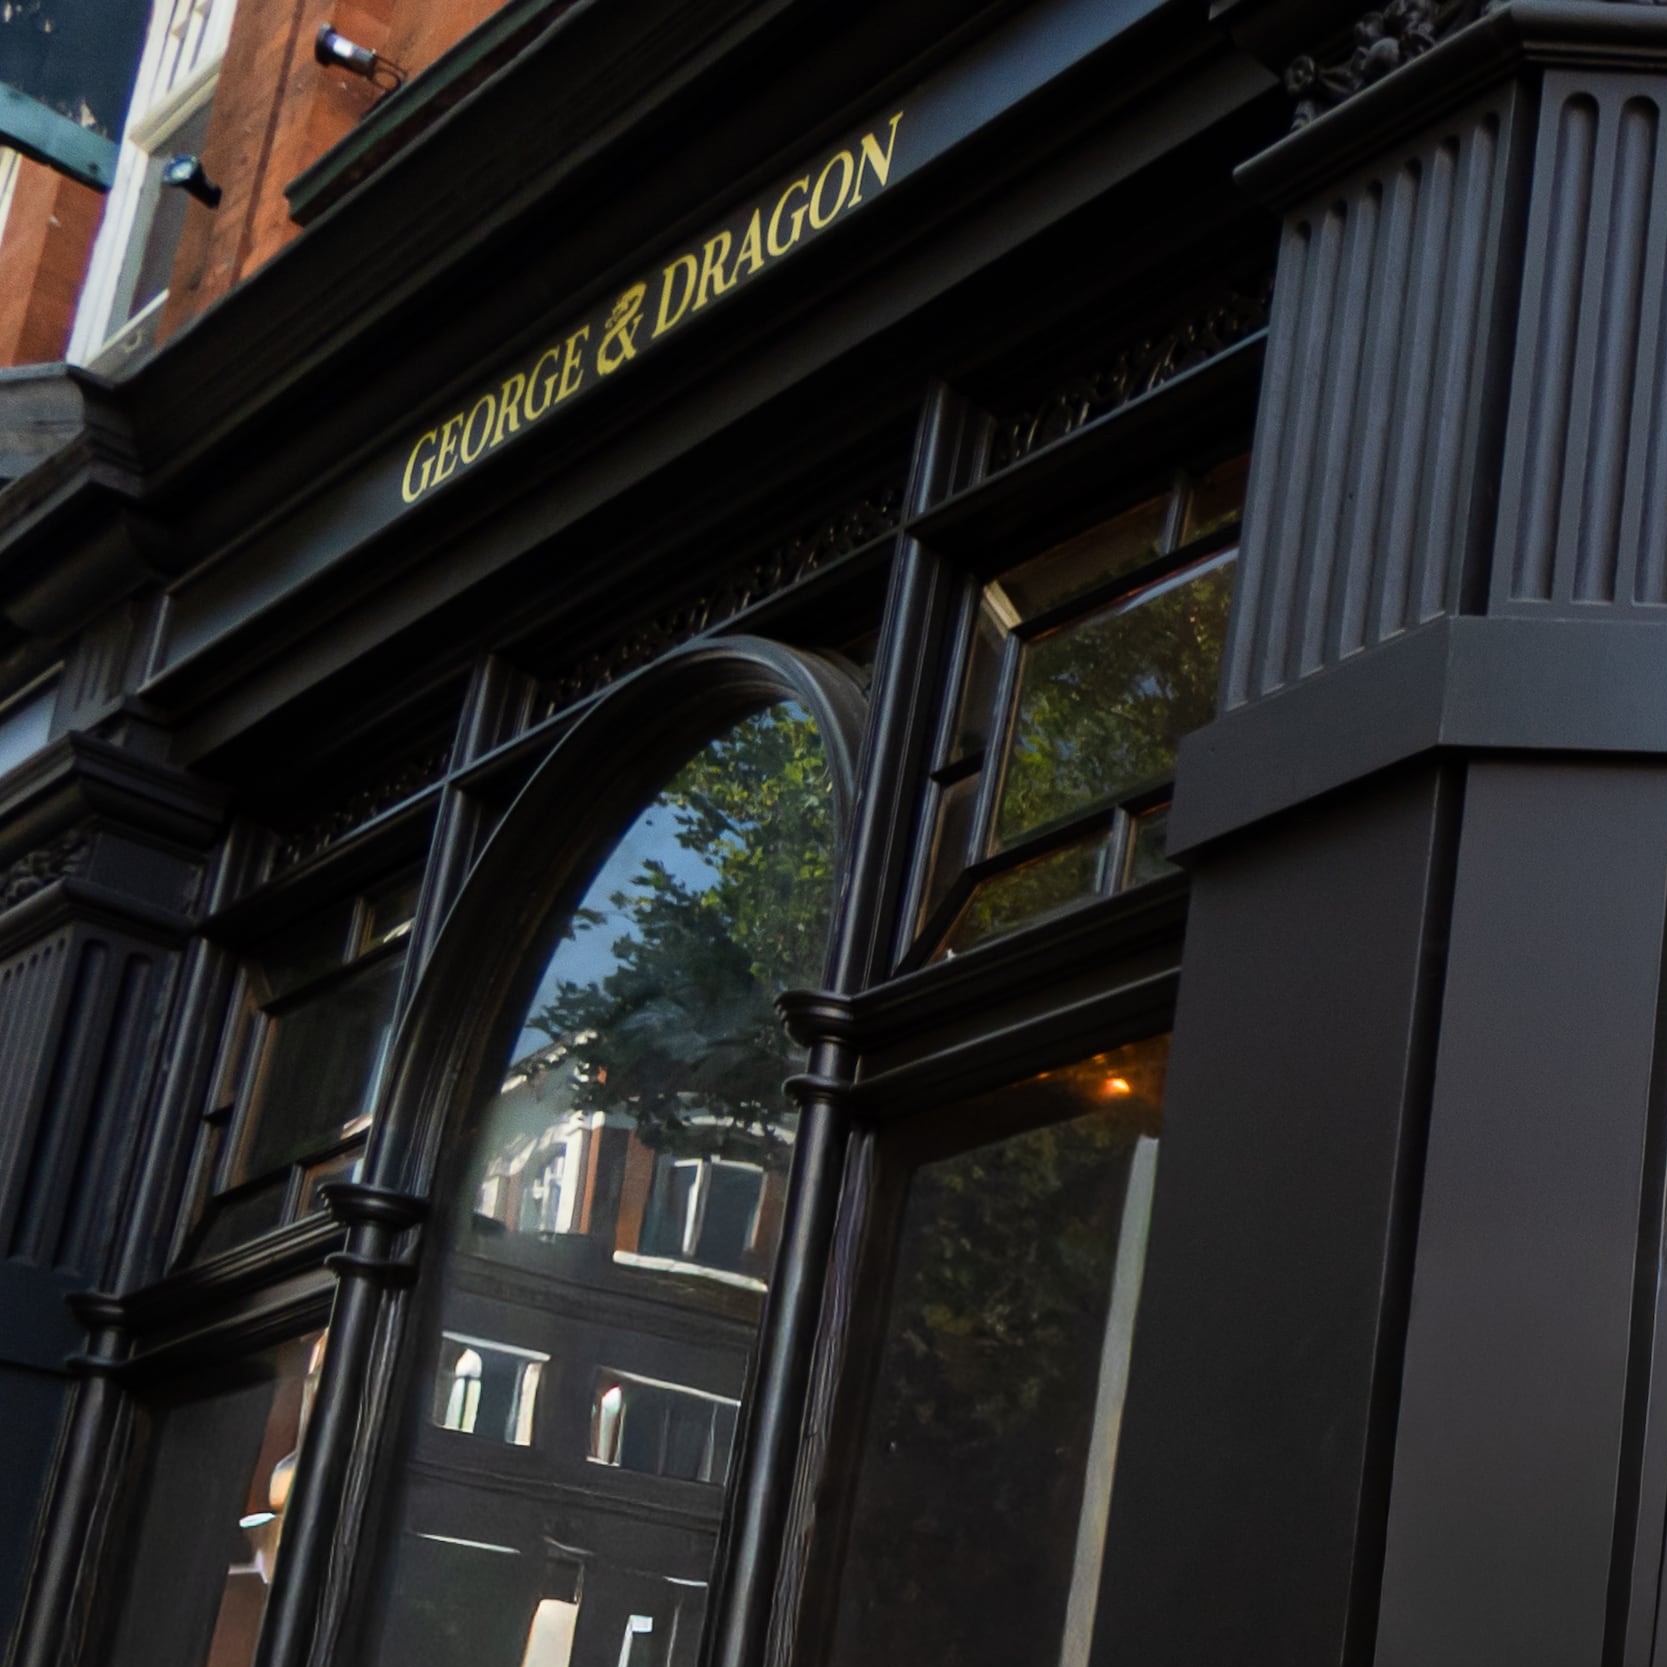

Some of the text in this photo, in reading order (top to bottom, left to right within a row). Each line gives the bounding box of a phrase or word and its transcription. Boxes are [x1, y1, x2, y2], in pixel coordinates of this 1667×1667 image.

[401, 111, 905, 502] GEORGE & DRAGON
